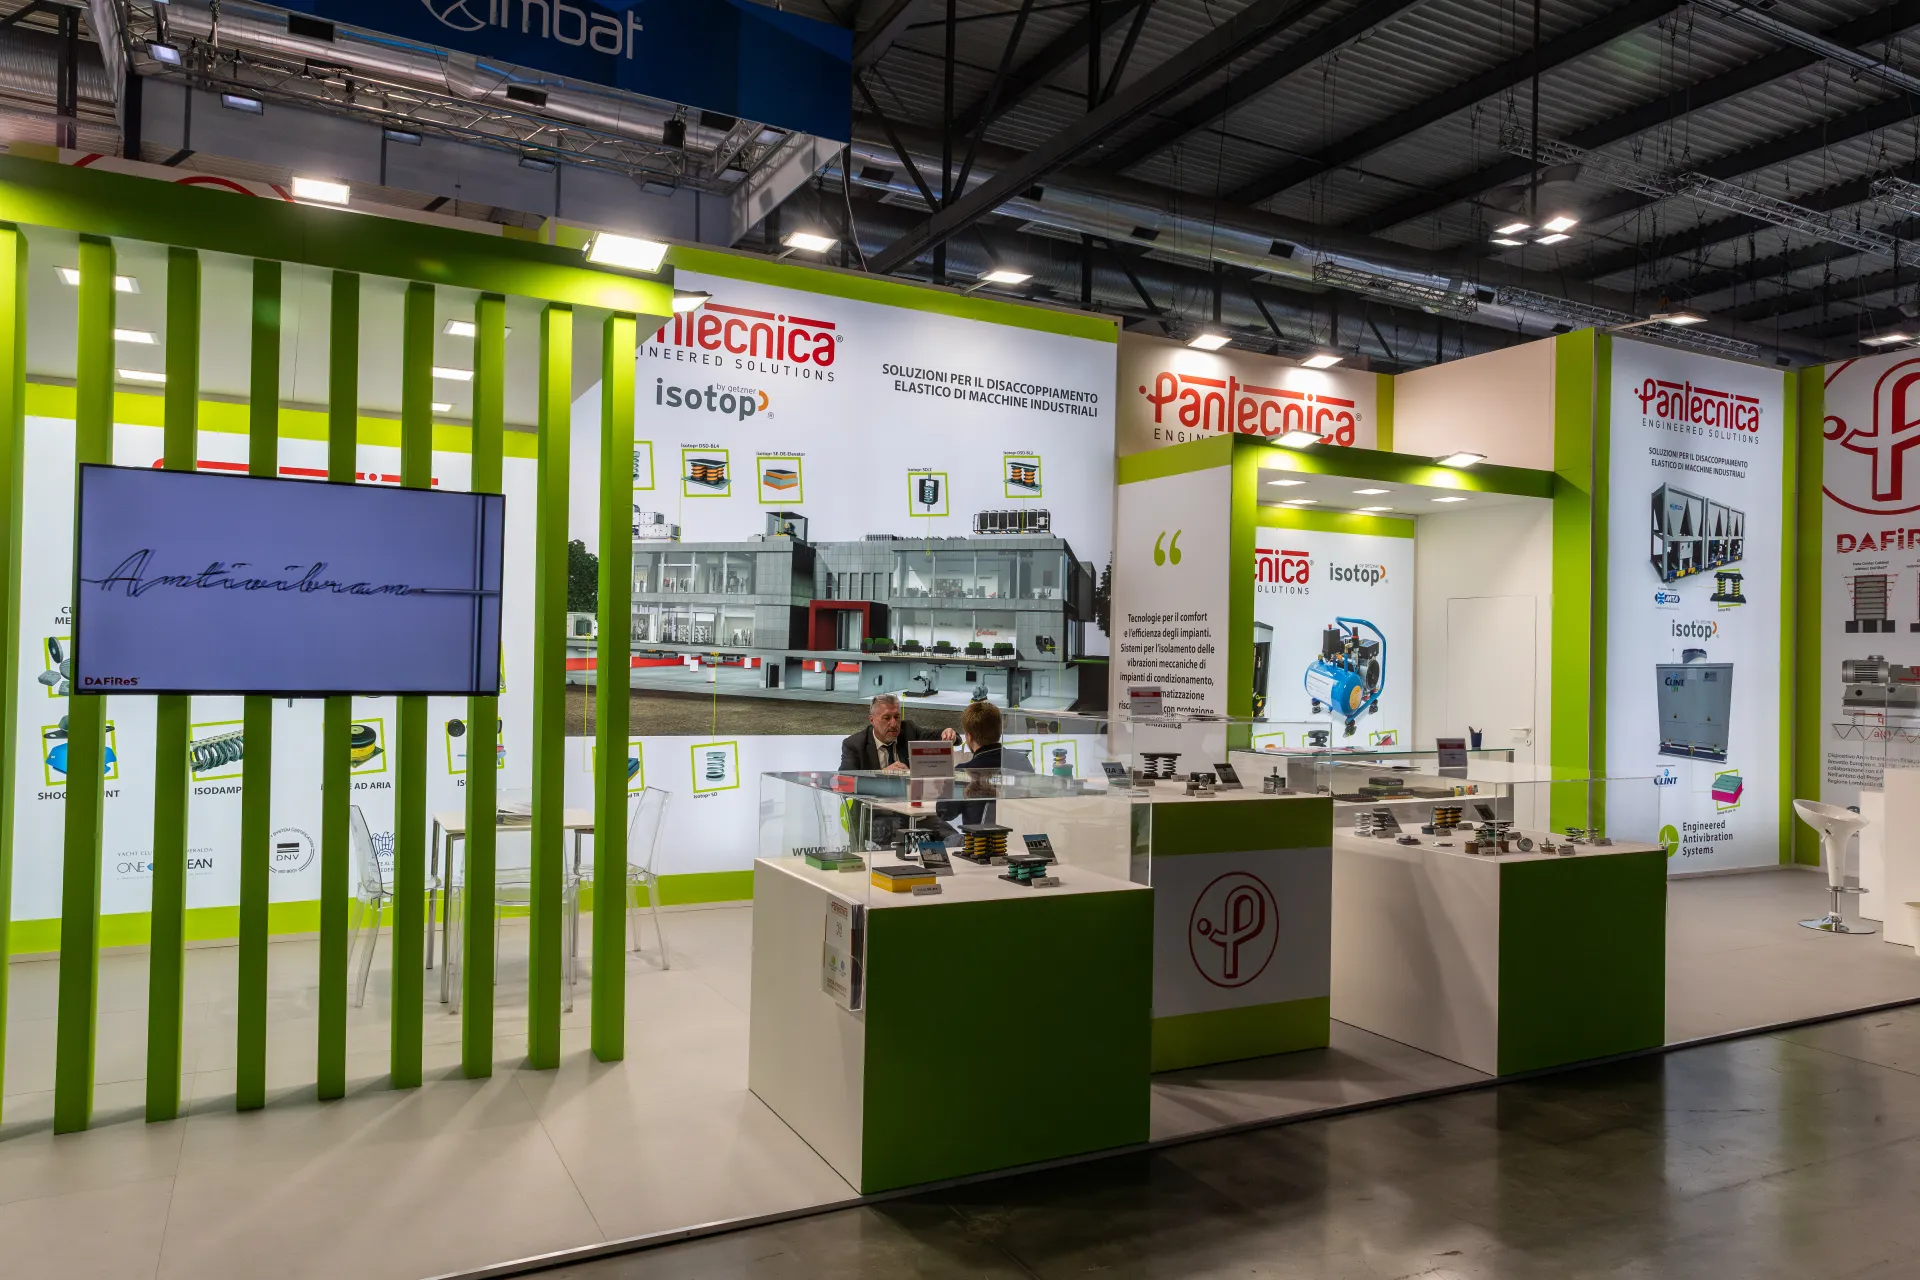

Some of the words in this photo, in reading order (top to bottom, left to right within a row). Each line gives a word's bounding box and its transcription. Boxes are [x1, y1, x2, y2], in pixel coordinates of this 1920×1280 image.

[636, 345, 723, 366] INEERED
[736, 359, 835, 382] SOLUTIONS
[716, 383, 726, 393] by
[727, 384, 756, 395] getzner
[882, 363, 947, 383] SOLUZIONI
[950, 373, 971, 386] PER
[974, 376, 984, 388] IL
[987, 378, 1098, 404] DISACCOPPIAMENTO
[894, 380, 951, 398] ELASTICO
[954, 388, 966, 400] DI
[969, 391, 1028, 409] MACCHINE
[1030, 398, 1098, 418] INDUSTRIALI
[1642, 417, 1703, 436] ENGINEERED
[1708, 429, 1759, 445] SOLUTIONS
[1649, 447, 1679, 457] SOLUZIONI
[1679, 451, 1689, 460] PER
[1689, 453, 1695, 461] IL
[1695, 453, 1748, 469] DISACCOPPIAMENTO
[1651, 458, 1677, 470] ELASTICO
[1677, 462, 1684, 470] DI
[1684, 463, 1713, 474] MACCHINE
[1713, 467, 1745, 479] INDUSTRIALI
[1330, 562, 1380, 587] isotop
[1128, 612, 1161, 624] Tecnologie
[1162, 613, 1174, 624] per
[1174, 613, 1180, 622] il
[1180, 611, 1207, 622] comfort
[1123, 630, 1128, 638] e
[1128, 628, 1161, 638] l'efficienza
[1162, 628, 1179, 640] degli
[1180, 628, 1212, 640] impianti.
[1672, 619, 1712, 642] isotop
[1120, 643, 1143, 653] Sistemi
[1143, 645, 1155, 655] per
[1155, 643, 1196, 654] l'isolamento
[1197, 644, 1215, 654] delle
[1127, 658, 1158, 668] vibrazioni
[1158, 658, 1198, 669] meccaniche
[1199, 659, 1207, 669] di
[1119, 672, 1145, 683] impianti
[1146, 672, 1153, 682] di
[1153, 673, 1214, 687] condizionamento,
[1163, 704, 1176, 714] con
[194, 786, 242, 795] ISODAMP
[354, 782, 368, 790] AD
[369, 781, 391, 790] ARIA
[1682, 819, 1726, 833] Engineered
[1682, 831, 1734, 844] Antivibration
[1682, 844, 1714, 858] Systems
[117, 862, 145, 874] ONE
